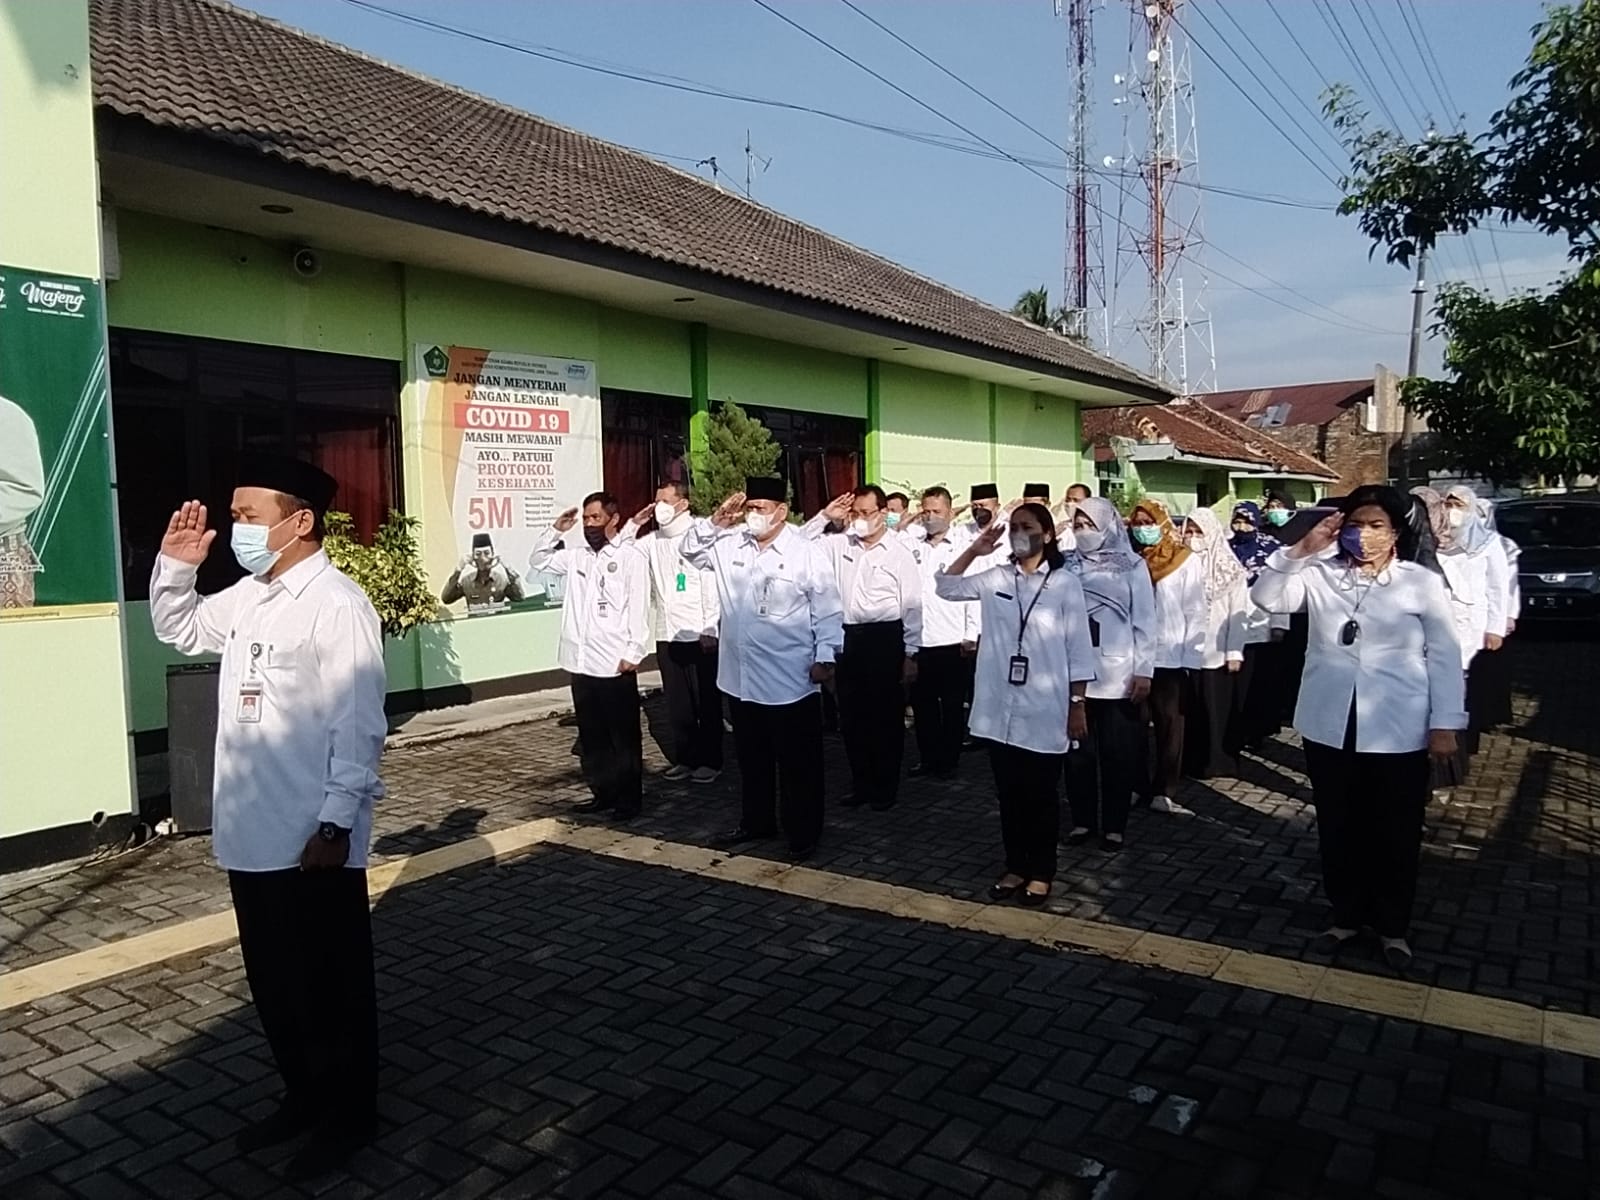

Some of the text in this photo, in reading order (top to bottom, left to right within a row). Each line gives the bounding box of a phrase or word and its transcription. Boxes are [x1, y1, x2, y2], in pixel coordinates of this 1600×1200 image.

[454, 372, 567, 392] JANGAN MENYERAH
[464, 390, 559, 407] JANGAN LENGAH
[465, 407, 560, 431] COVID 19
[465, 432, 563, 446] MASIH MEWABAH
[512, 452, 553, 463] PATUHI
[477, 463, 554, 476] PROTOKOL
[477, 478, 555, 489] KESEHATAN
[468, 496, 513, 530] 5M
